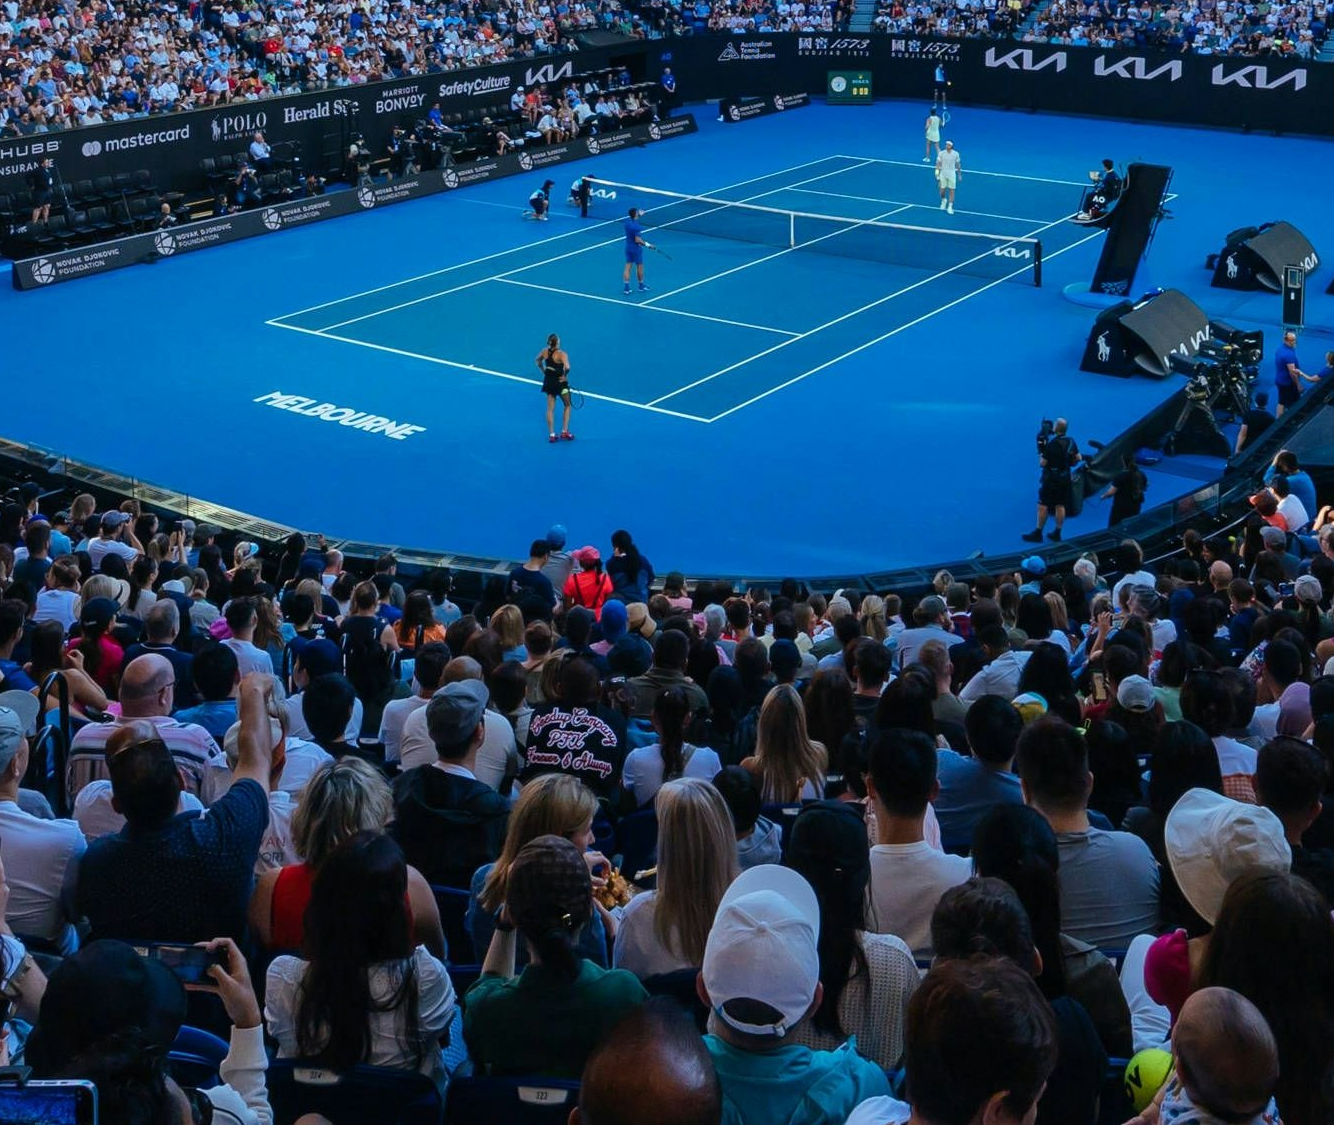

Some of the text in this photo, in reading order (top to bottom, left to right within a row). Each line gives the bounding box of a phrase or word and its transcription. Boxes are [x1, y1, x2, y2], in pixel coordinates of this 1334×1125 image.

[829, 38, 870, 49] 1573
[985, 47, 1067, 73] KIA
[1094, 53, 1182, 82] KIA
[525, 60, 573, 86] KIA
[1212, 60, 1308, 91] KIA
[382, 85, 419, 98] MARRIOTT
[438, 75, 511, 97] SafetyCulture
[283, 102, 330, 124] Herald
[375, 93, 425, 114] BONVOY
[223, 111, 267, 134] POLO
[105, 124, 190, 152] mastercard
[56, 248, 120, 269] NOVAK DJOKOVIC
[994, 245, 1030, 260] KIA
[59, 260, 106, 275] FOUNDATION
[252, 390, 428, 441] MELBOURNE
